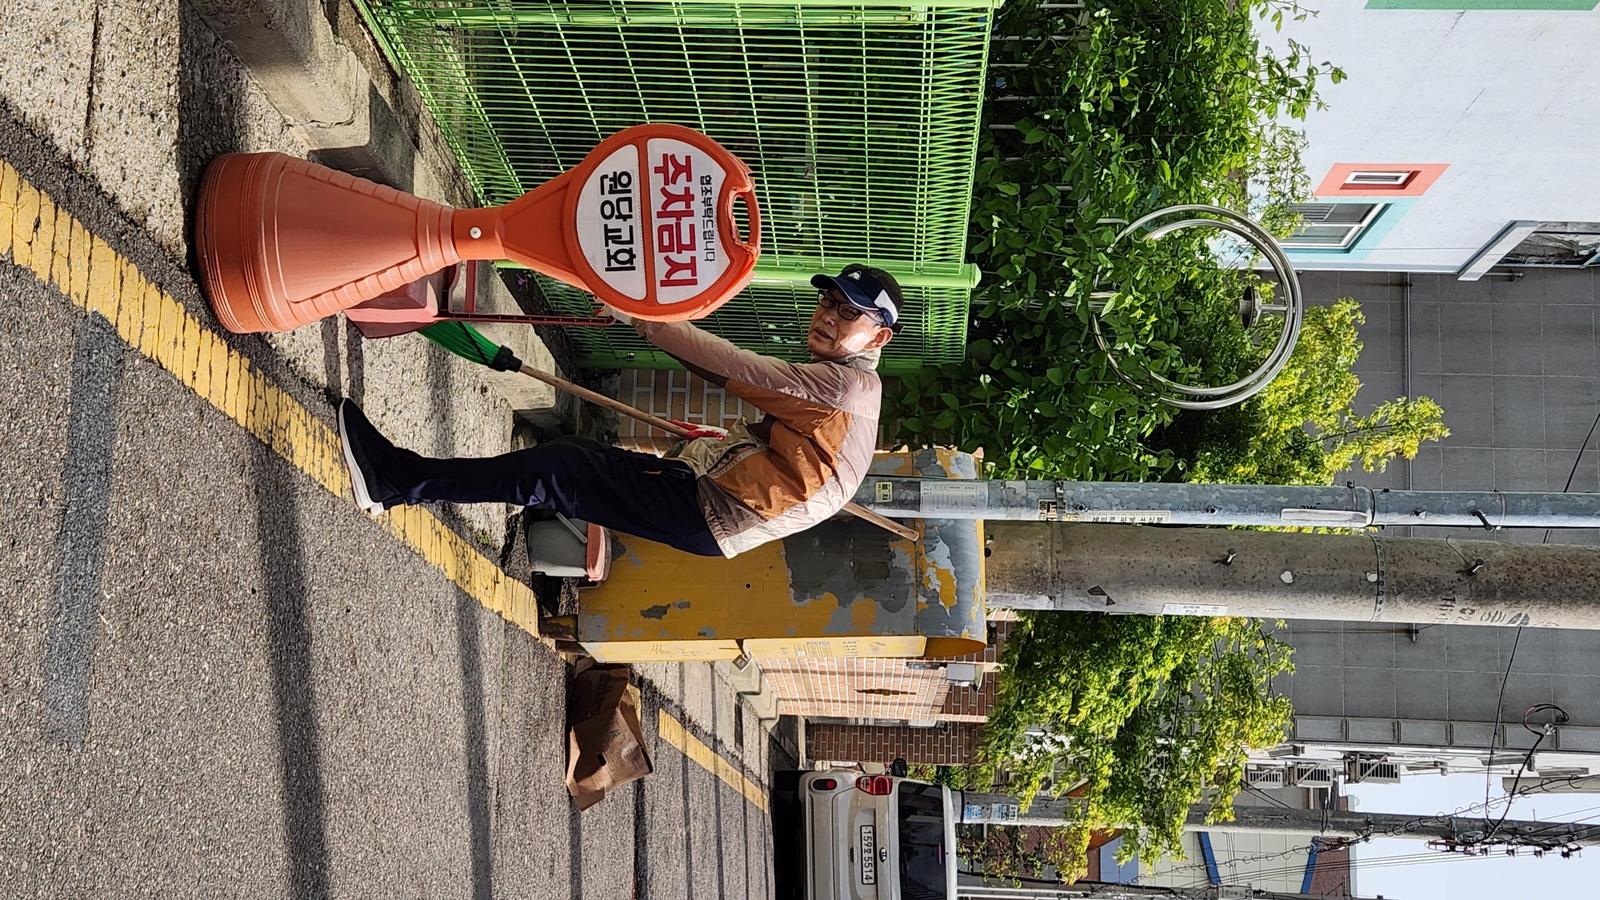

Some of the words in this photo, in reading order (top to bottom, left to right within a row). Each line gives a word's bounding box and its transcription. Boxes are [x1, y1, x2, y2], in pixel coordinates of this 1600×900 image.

[600, 171, 636, 273] 원당교회
[654, 154, 697, 287] 주차금지
[700, 175, 715, 262] 협조부탁드립니다
[864, 856, 873, 880] 5514
